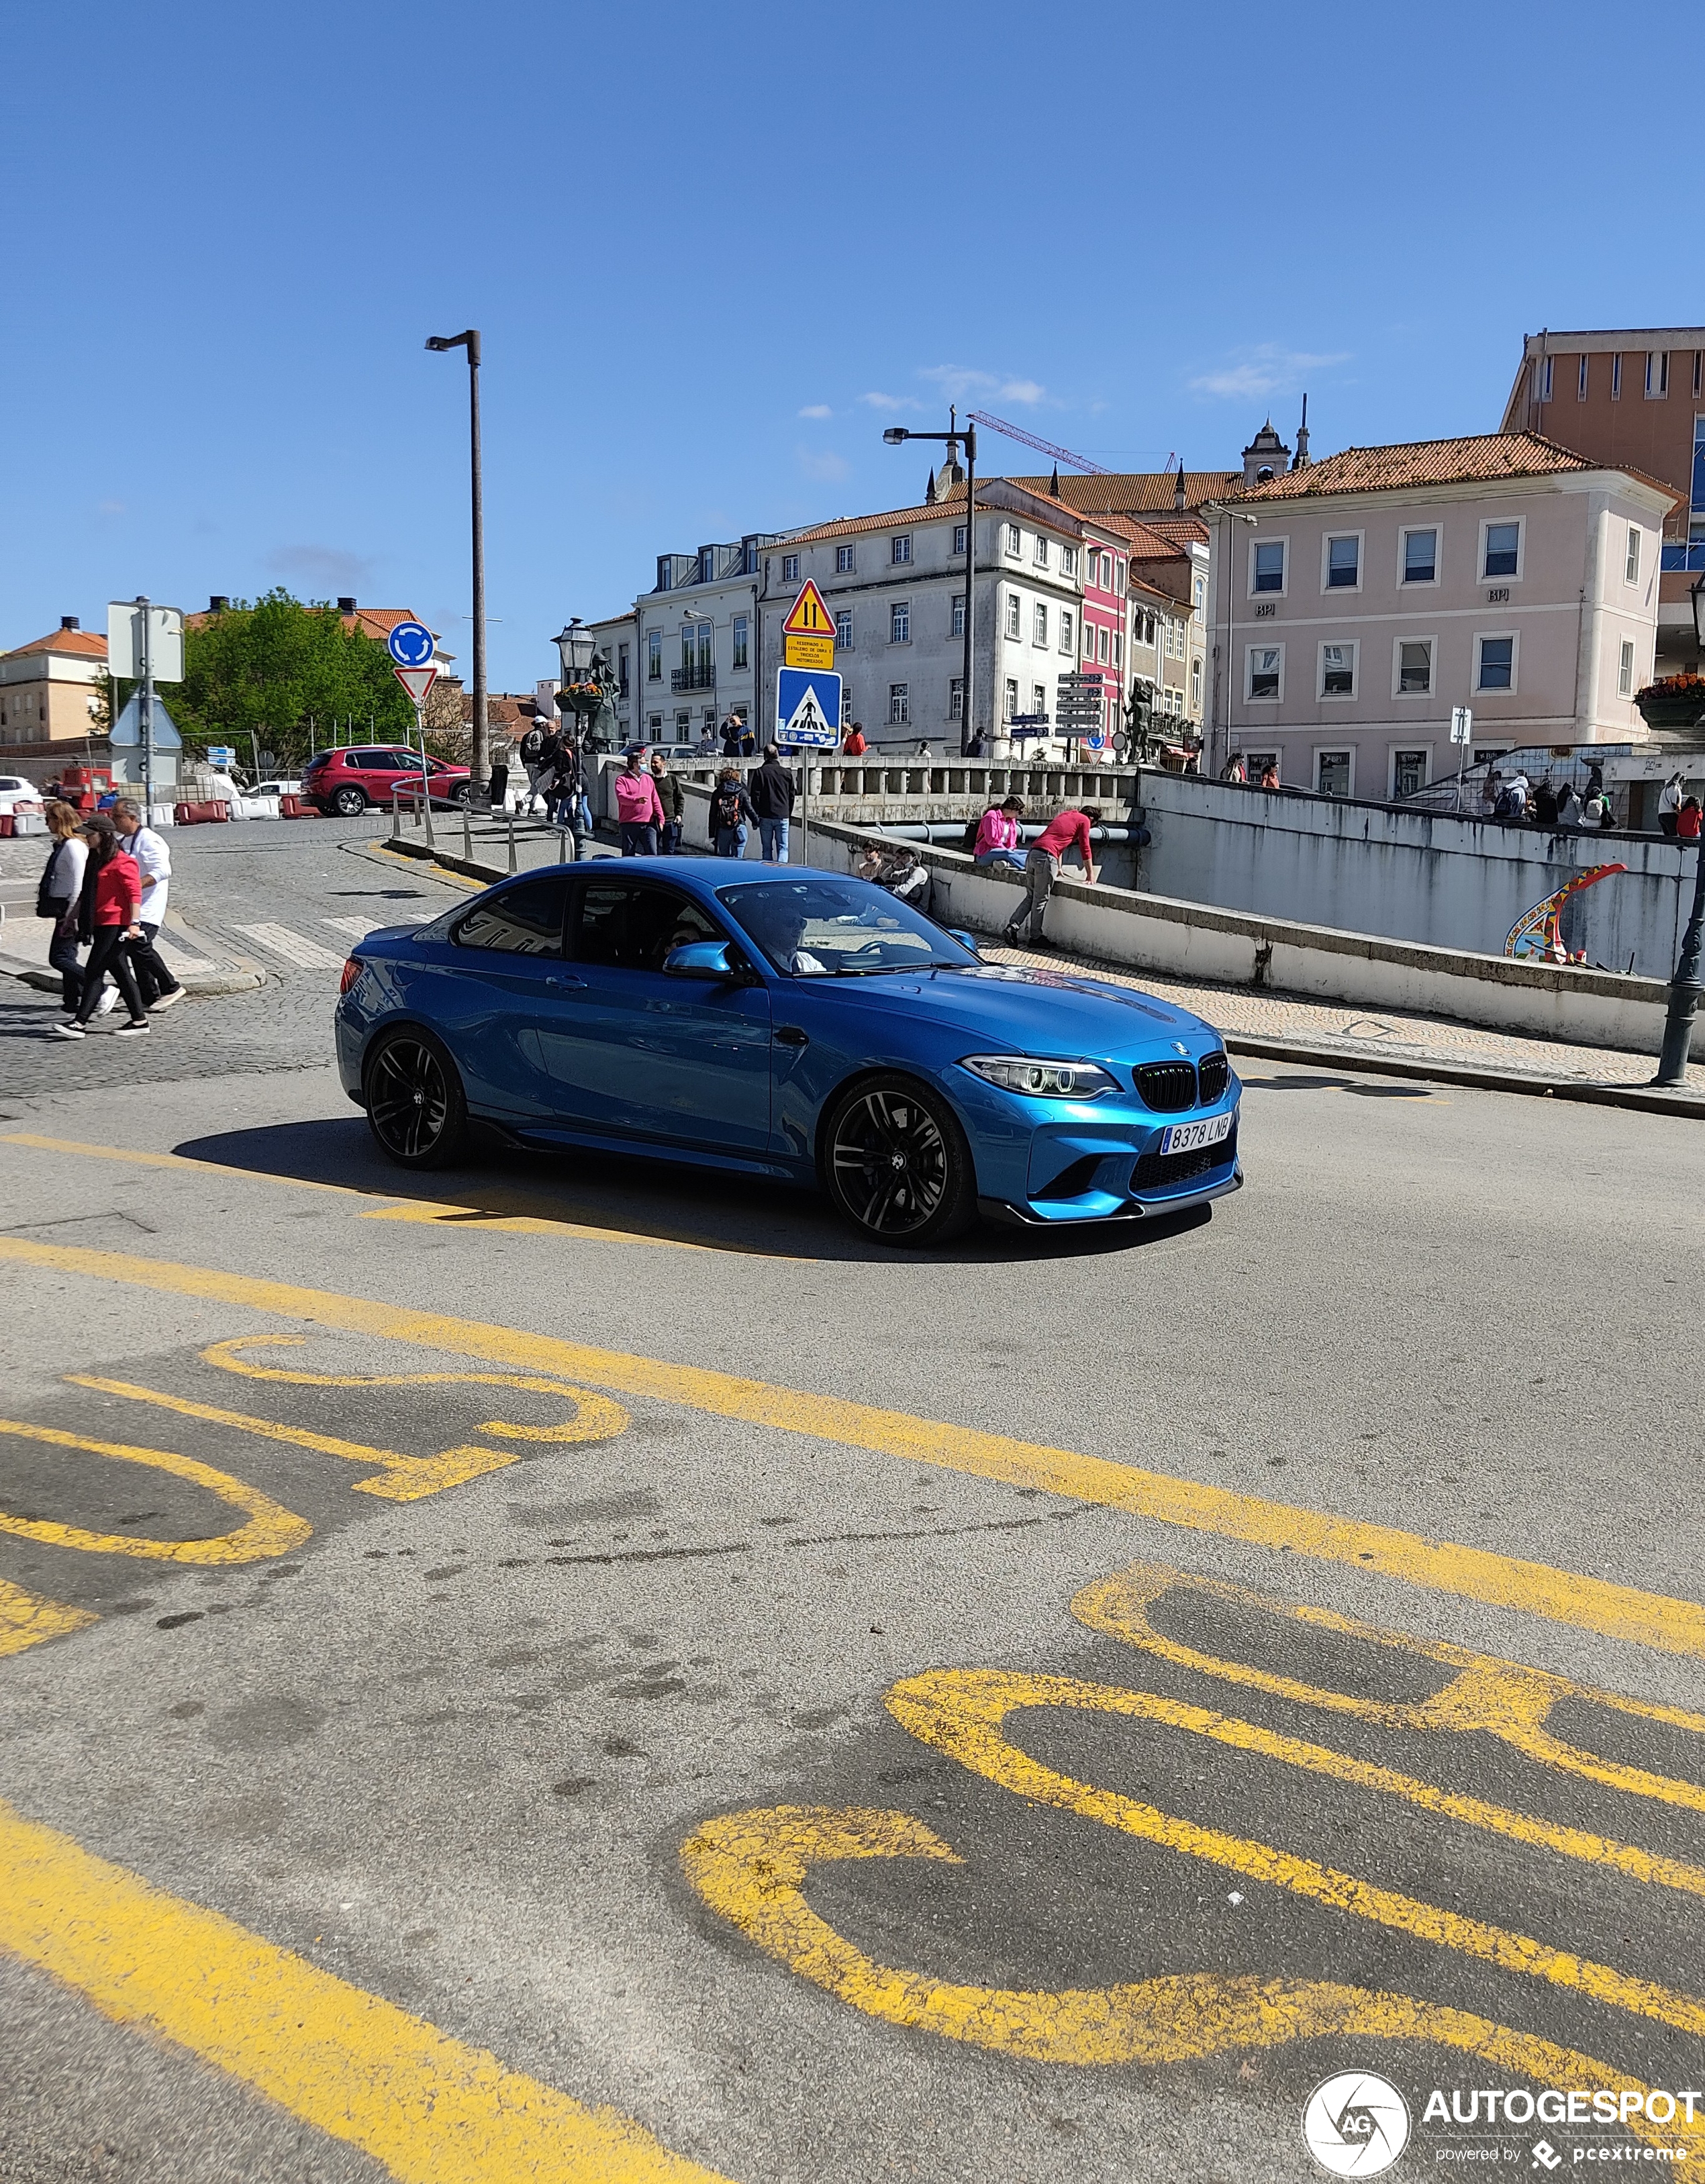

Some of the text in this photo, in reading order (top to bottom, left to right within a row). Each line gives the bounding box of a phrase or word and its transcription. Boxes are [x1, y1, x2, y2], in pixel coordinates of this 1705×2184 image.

[1488, 589, 1509, 602] BPI
[1256, 603, 1275, 616] BPI
[1172, 1117, 1228, 1149] 8378 LNB
